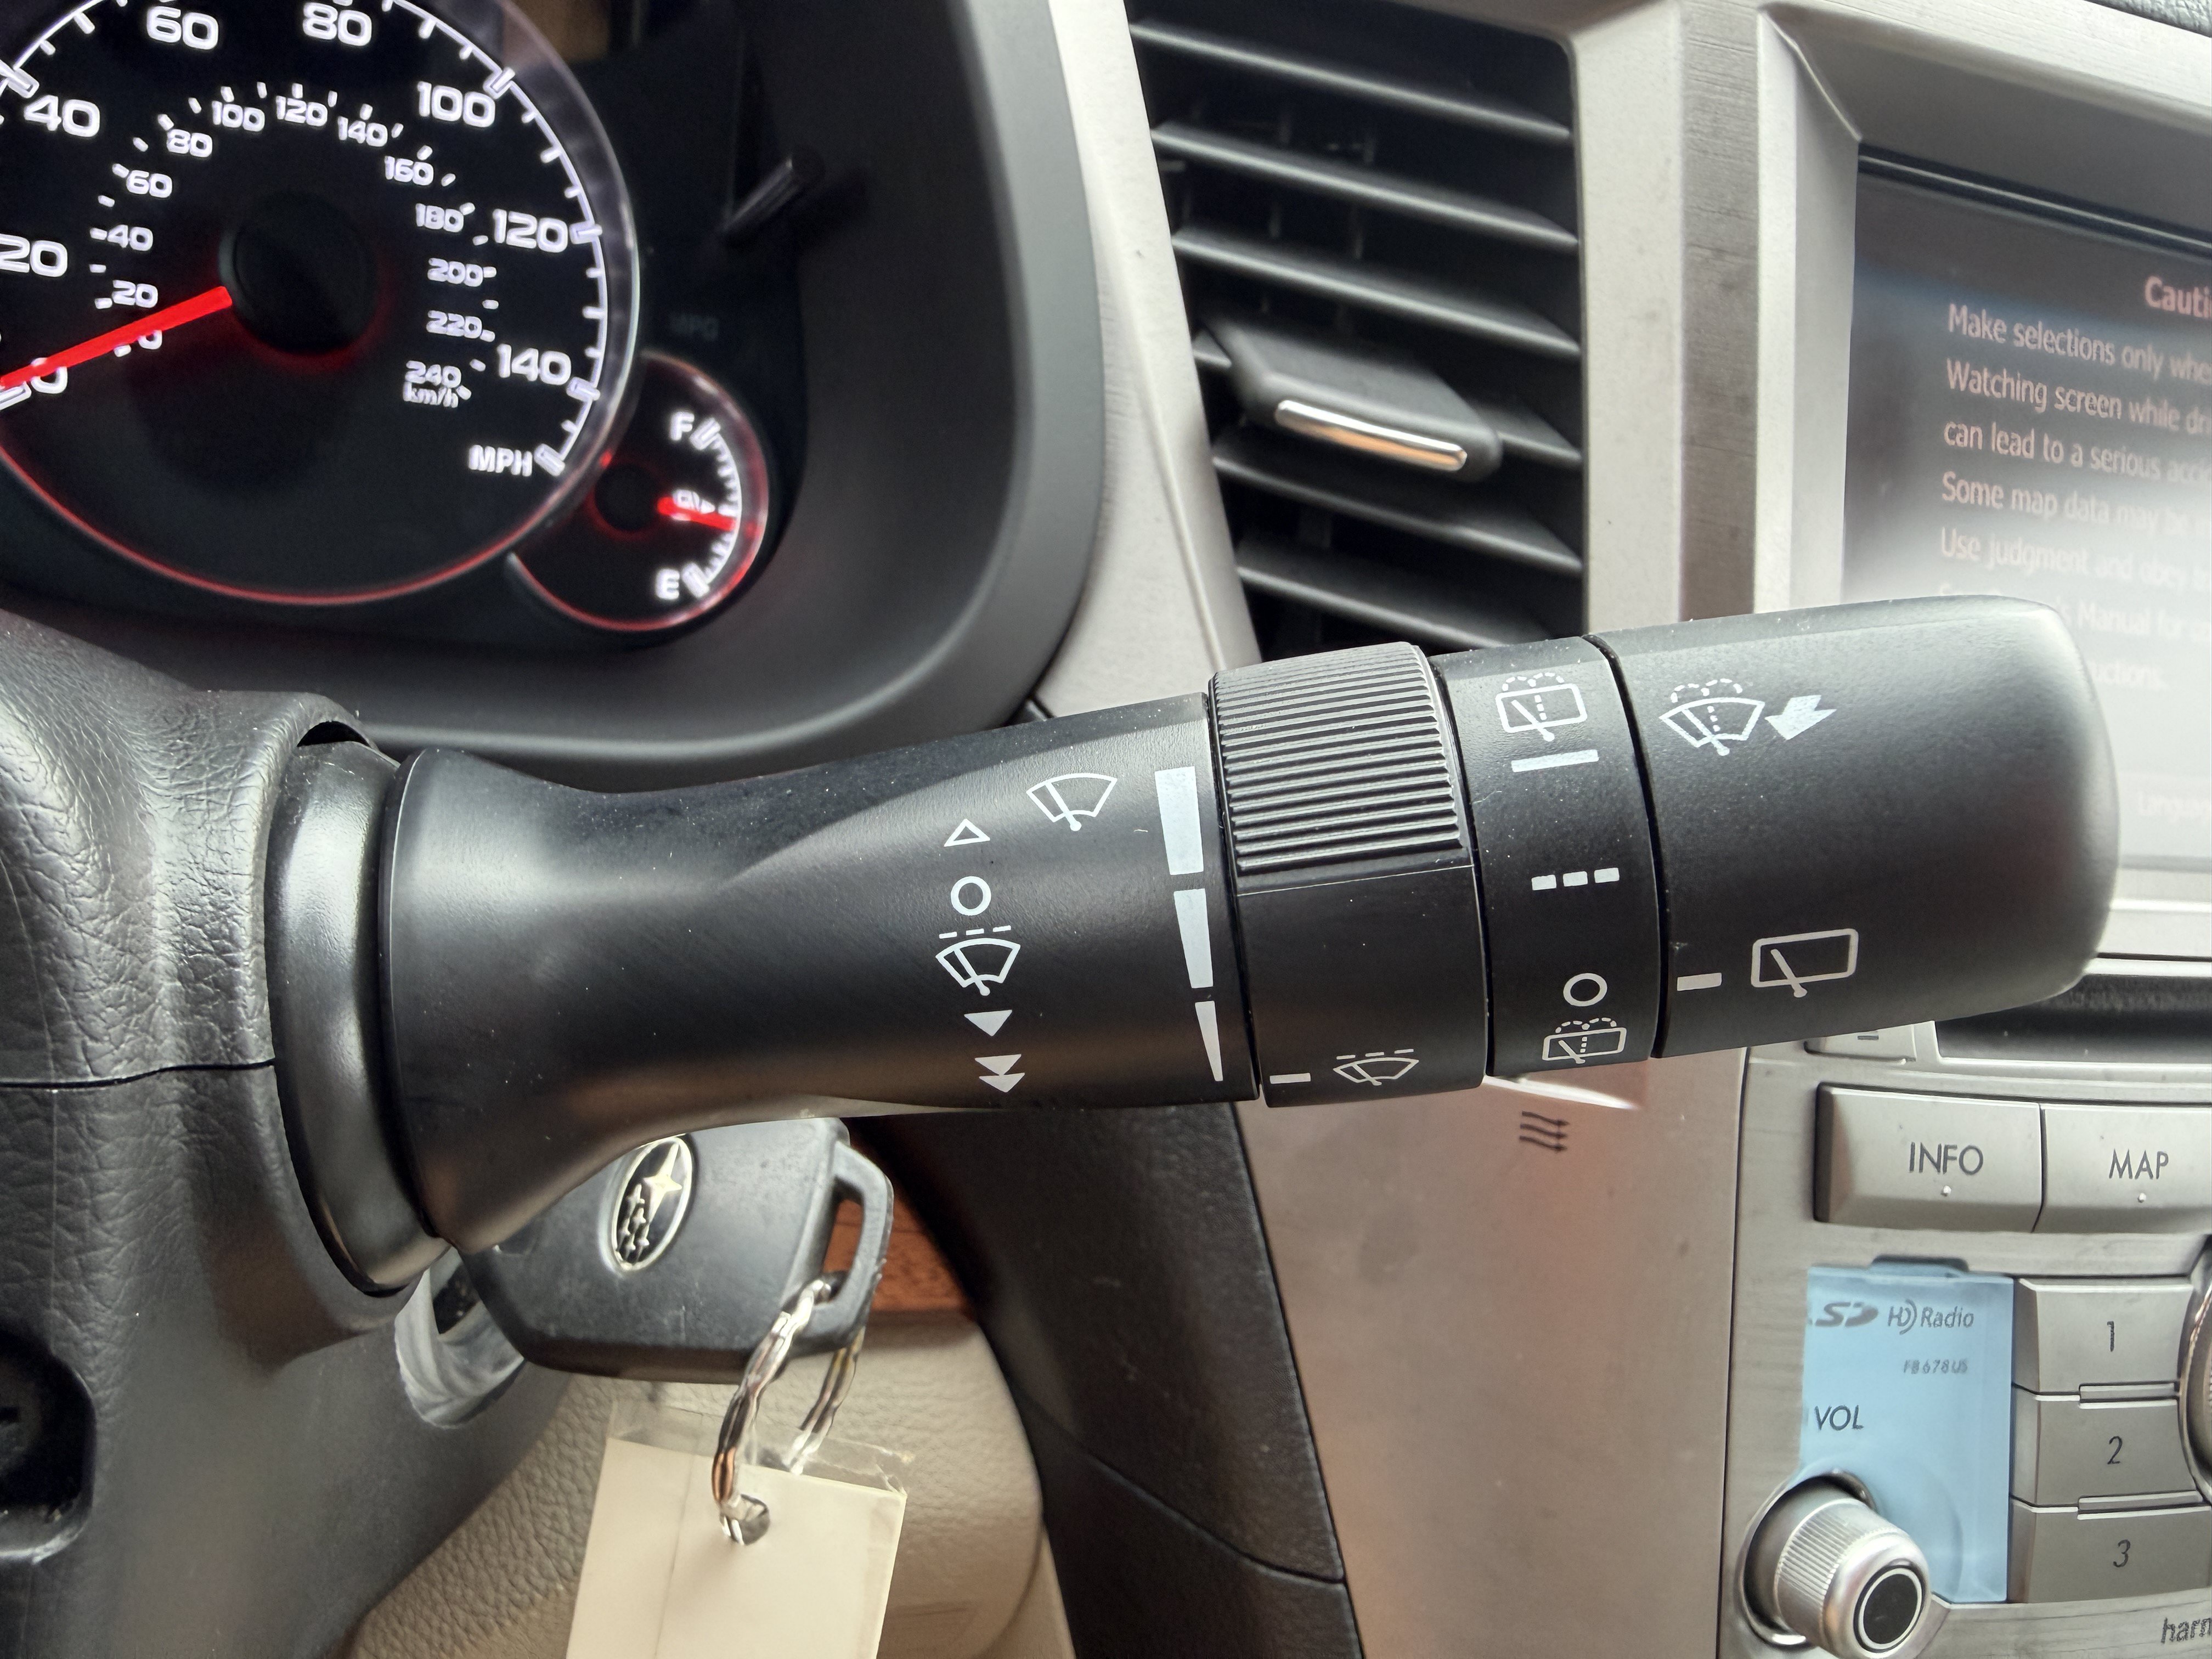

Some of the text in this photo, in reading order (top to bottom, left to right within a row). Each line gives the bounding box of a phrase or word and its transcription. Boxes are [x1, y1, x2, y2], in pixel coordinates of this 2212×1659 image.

[146, 6, 219, 50] 60
[302, 2, 372, 47] 80
[24, 94, 100, 137] 40
[211, 100, 265, 132] 100
[275, 95, 328, 127] 120
[417, 81, 495, 127] 100
[166, 128, 213, 157] 80
[337, 116, 388, 147] 140
[126, 170, 172, 198] 60
[384, 155, 434, 186] 160
[415, 203, 464, 233] 180
[493, 208, 568, 253] 120
[107, 224, 153, 251] 40
[0, 233, 68, 276] 20
[427, 257, 484, 287] 200
[112, 280, 158, 308] 20
[2145, 275, 2212, 320] Cauti
[426, 310, 482, 338] 220
[1948, 303, 2007, 343] Make
[2012, 320, 2115, 366] selections
[2121, 342, 2164, 381] only
[405, 360, 461, 388] 240
[496, 343, 571, 385] 140
[403, 381, 459, 408] km/h
[1946, 358, 2047, 413] Watching
[2054, 386, 2122, 420] screen
[2129, 395, 2181, 432] while
[670, 412, 693, 441] F
[468, 445, 533, 477] MPH
[1944, 422, 1983, 450] can
[1991, 421, 2034, 459] lead
[2044, 433, 2064, 464] to
[2070, 443, 2083, 467] a
[2090, 445, 2161, 480] serious
[1942, 471, 2004, 510] Some
[2011, 488, 2058, 521] map
[2064, 490, 2110, 524] data
[1940, 527, 1981, 561] Use
[1988, 532, 2089, 576] judgment
[657, 569, 679, 600] E
[1909, 1142, 1984, 1175] INFO
[2108, 1149, 2169, 1180] MAP
[1920, 1306, 1975, 1328] Radio
[2107, 1321, 2115, 1352] 1
[1815, 1405, 1864, 1430] VOL
[2107, 1436, 2124, 1465] 2
[2113, 1540, 2131, 1567] 3
